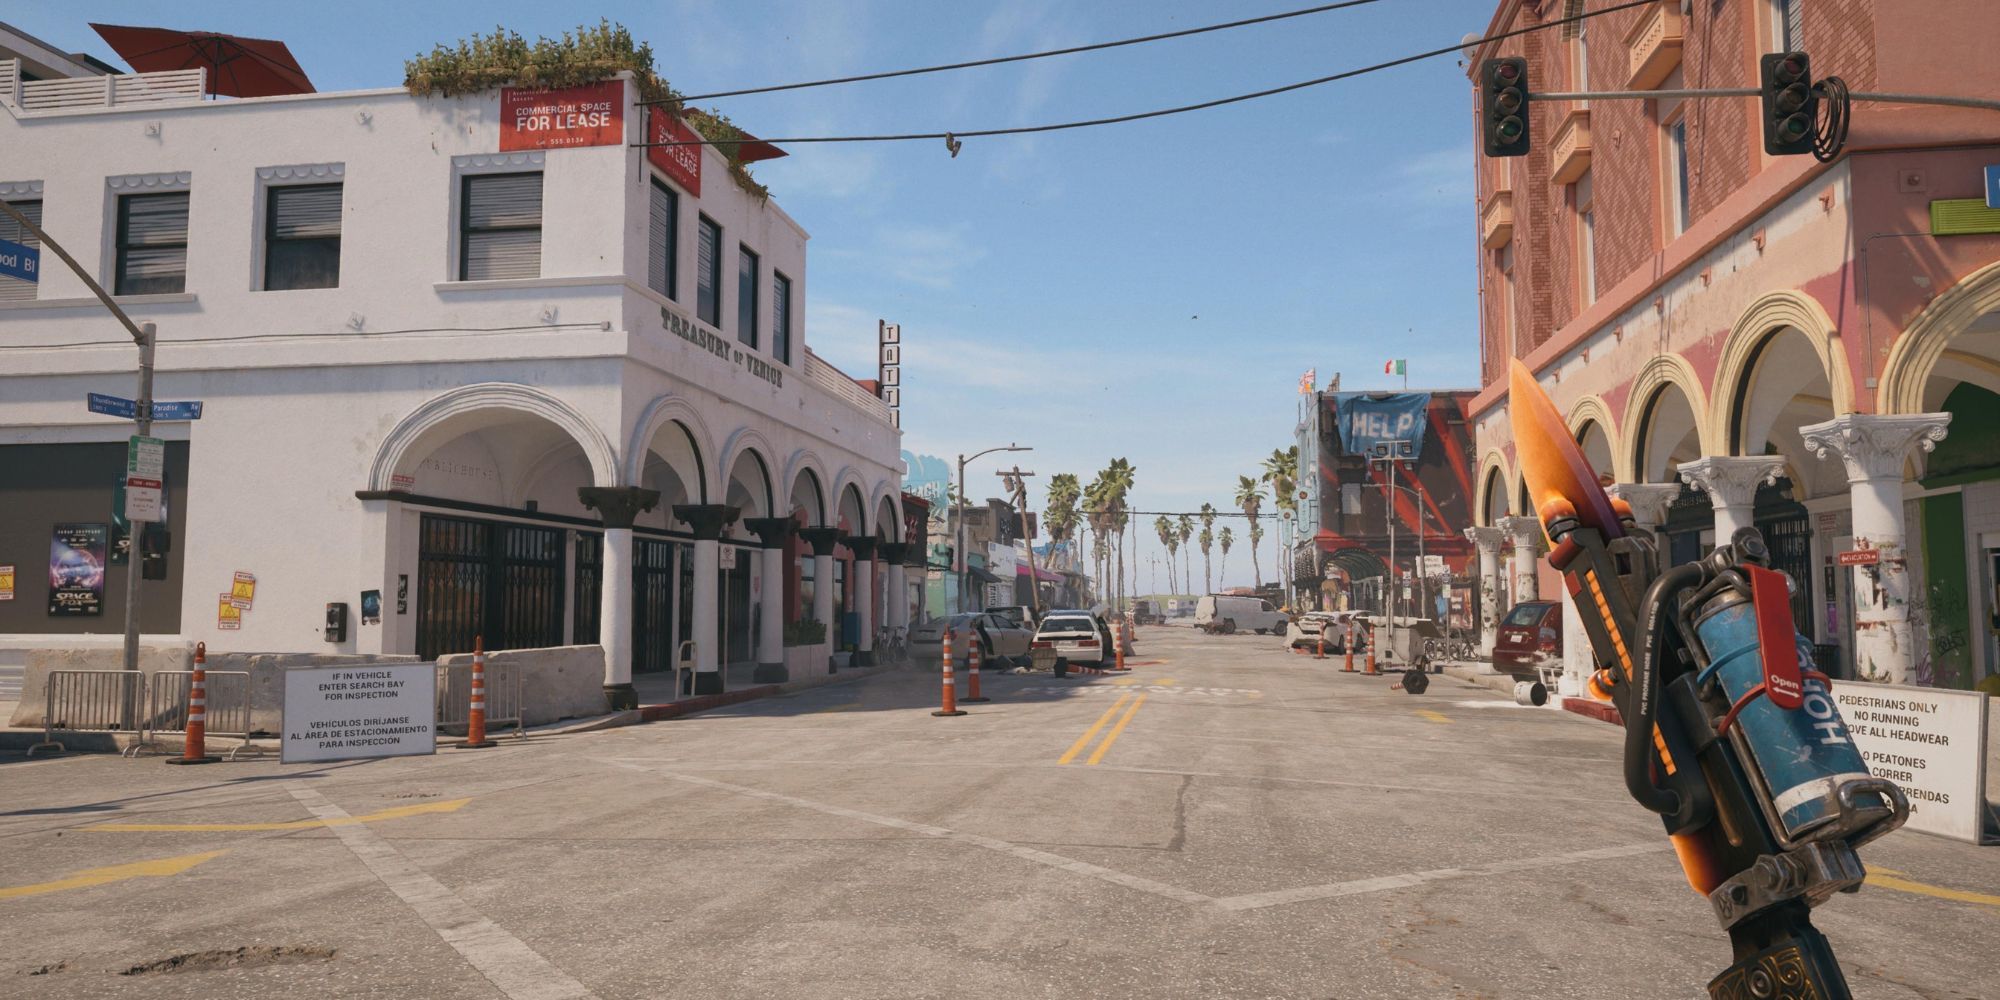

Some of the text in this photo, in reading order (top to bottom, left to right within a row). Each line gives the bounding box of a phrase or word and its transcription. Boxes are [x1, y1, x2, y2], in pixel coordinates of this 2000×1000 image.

[516, 101, 612, 117] COMMERCIAL SPACE
[516, 112, 611, 132] FOR LEASE
[675, 148, 697, 178] LEASE
[24, 257, 36, 273] Bl
[660, 305, 783, 389] TREASURY OF VENICE
[153, 404, 178, 412] Paradise
[1352, 411, 1414, 439] HELP
[56, 592, 94, 600] SPACE
[332, 671, 393, 681] IF IN VEHICLE
[1770, 674, 1799, 690] Open
[318, 680, 405, 692] ENTER SEARCH BAY
[325, 690, 399, 701] FOR INSPECTION
[1839, 695, 1938, 714] PEDESTRIANS ONLY
[310, 716, 410, 729] VEHÍCULOS DIRÍJANSE
[1854, 710, 1920, 727] NO RUNNING
[290, 725, 428, 740] AL ÁREA DE ESTACIONAMIENTO
[1869, 726, 1888, 738] ALL
[1890, 729, 1949, 746] HEADWEAR
[319, 736, 400, 749] PARA INSPECCIÓN
[1872, 752, 1926, 769] PEATONES
[1872, 767, 1913, 782] CORRER
